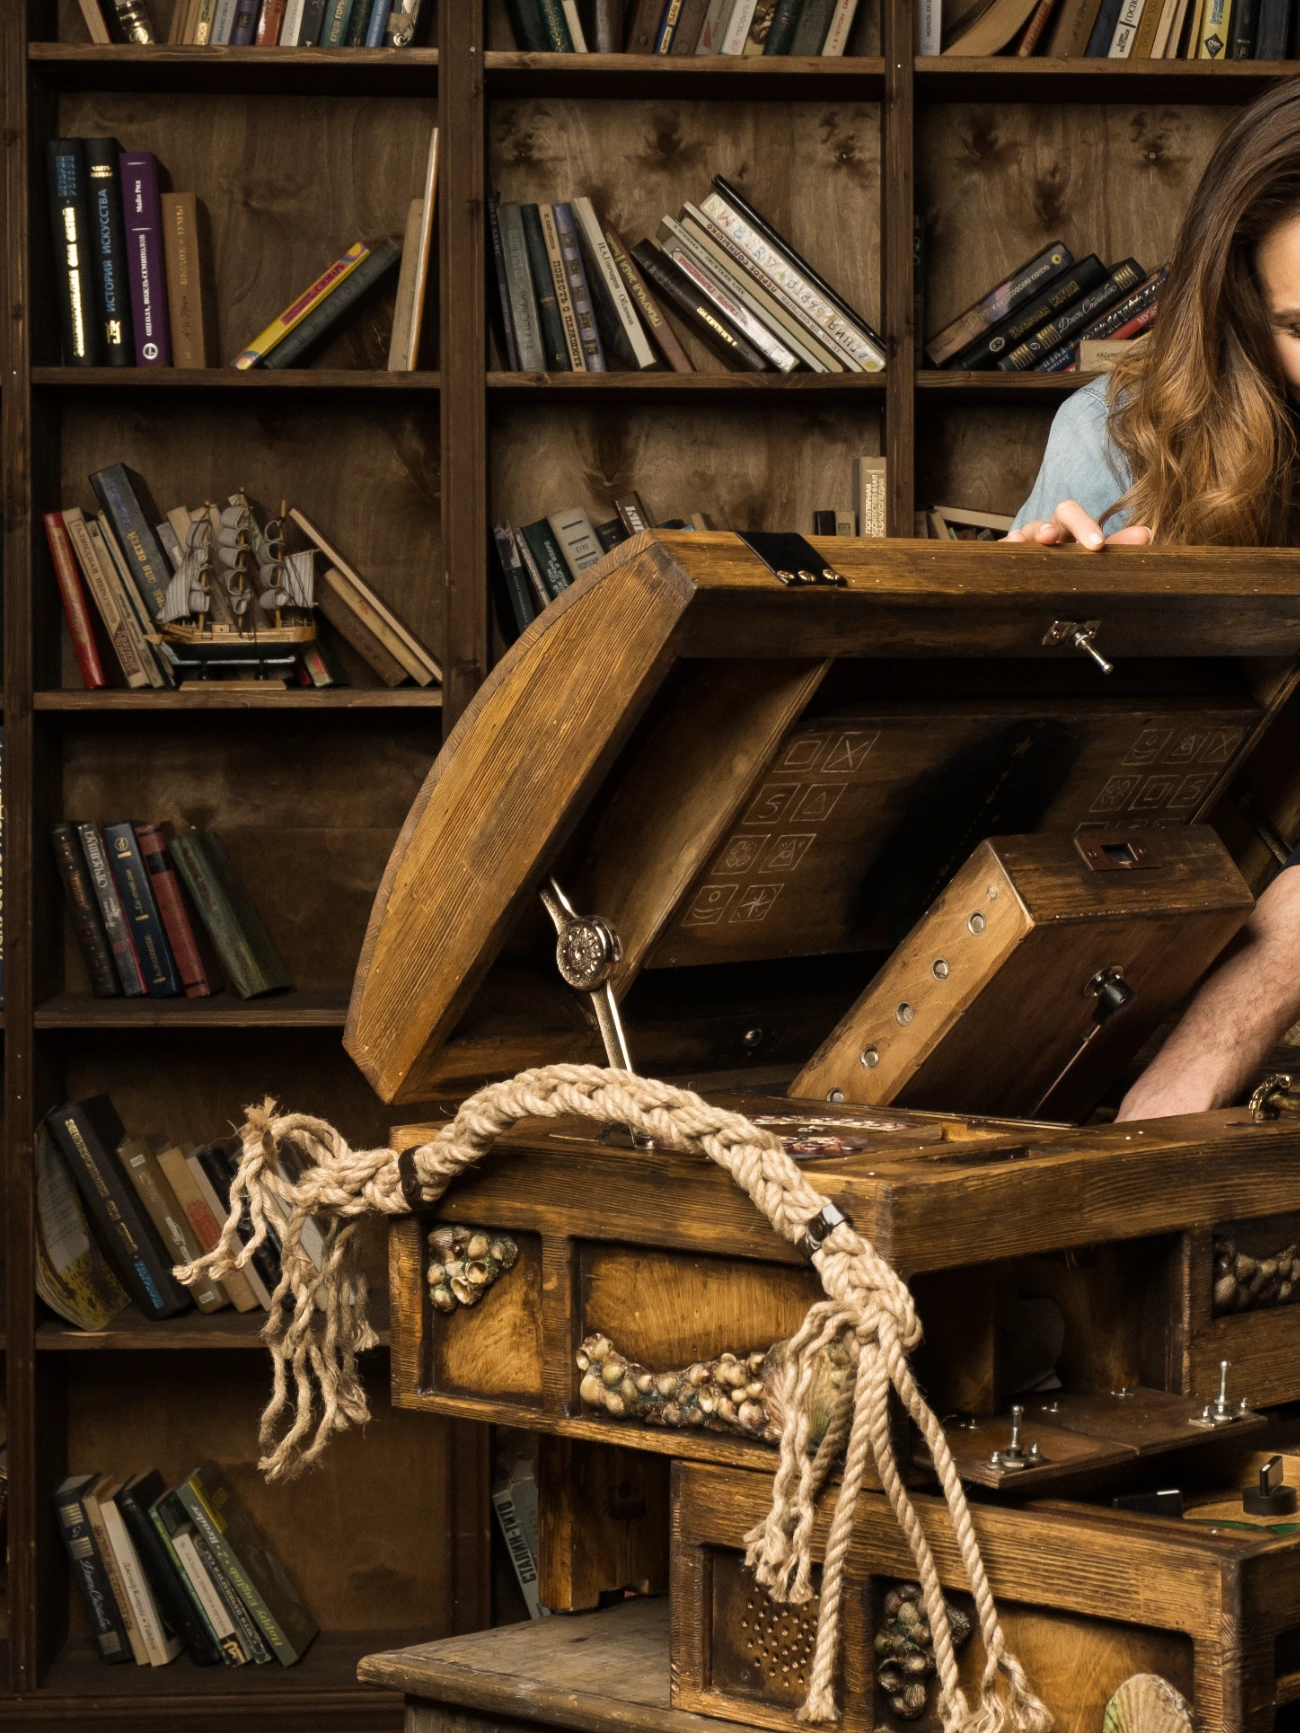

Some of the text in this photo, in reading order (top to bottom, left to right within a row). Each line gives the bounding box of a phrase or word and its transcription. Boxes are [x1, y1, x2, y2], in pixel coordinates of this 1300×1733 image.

[96, 188, 116, 312] ИСТОРИЯ ИСКУССТВА
[705, 219, 778, 294] ПЕРВОЕ СОЛНЫШКО
[551, 259, 569, 304] ПОВЕСТЬ
[563, 315, 583, 368] ПАРАШЮТЕ
[618, 259, 662, 329] ГРЕМУЧАЯ ЗМЕЯ
[864, 483, 872, 533] ПОПУЛЯРНАЯ
[870, 474, 878, 537] УДОЖЕСТВЕННАЯ
[125, 530, 157, 584] ДЛЯ ДЕТЕЙ
[188, 1502, 220, 1546] Reader
[495, 1499, 538, 1585] СТАЛИН-ТИТО
[216, 1548, 229, 1563] 2
[227, 1564, 260, 1609] English
[253, 1606, 285, 1649] Happy
